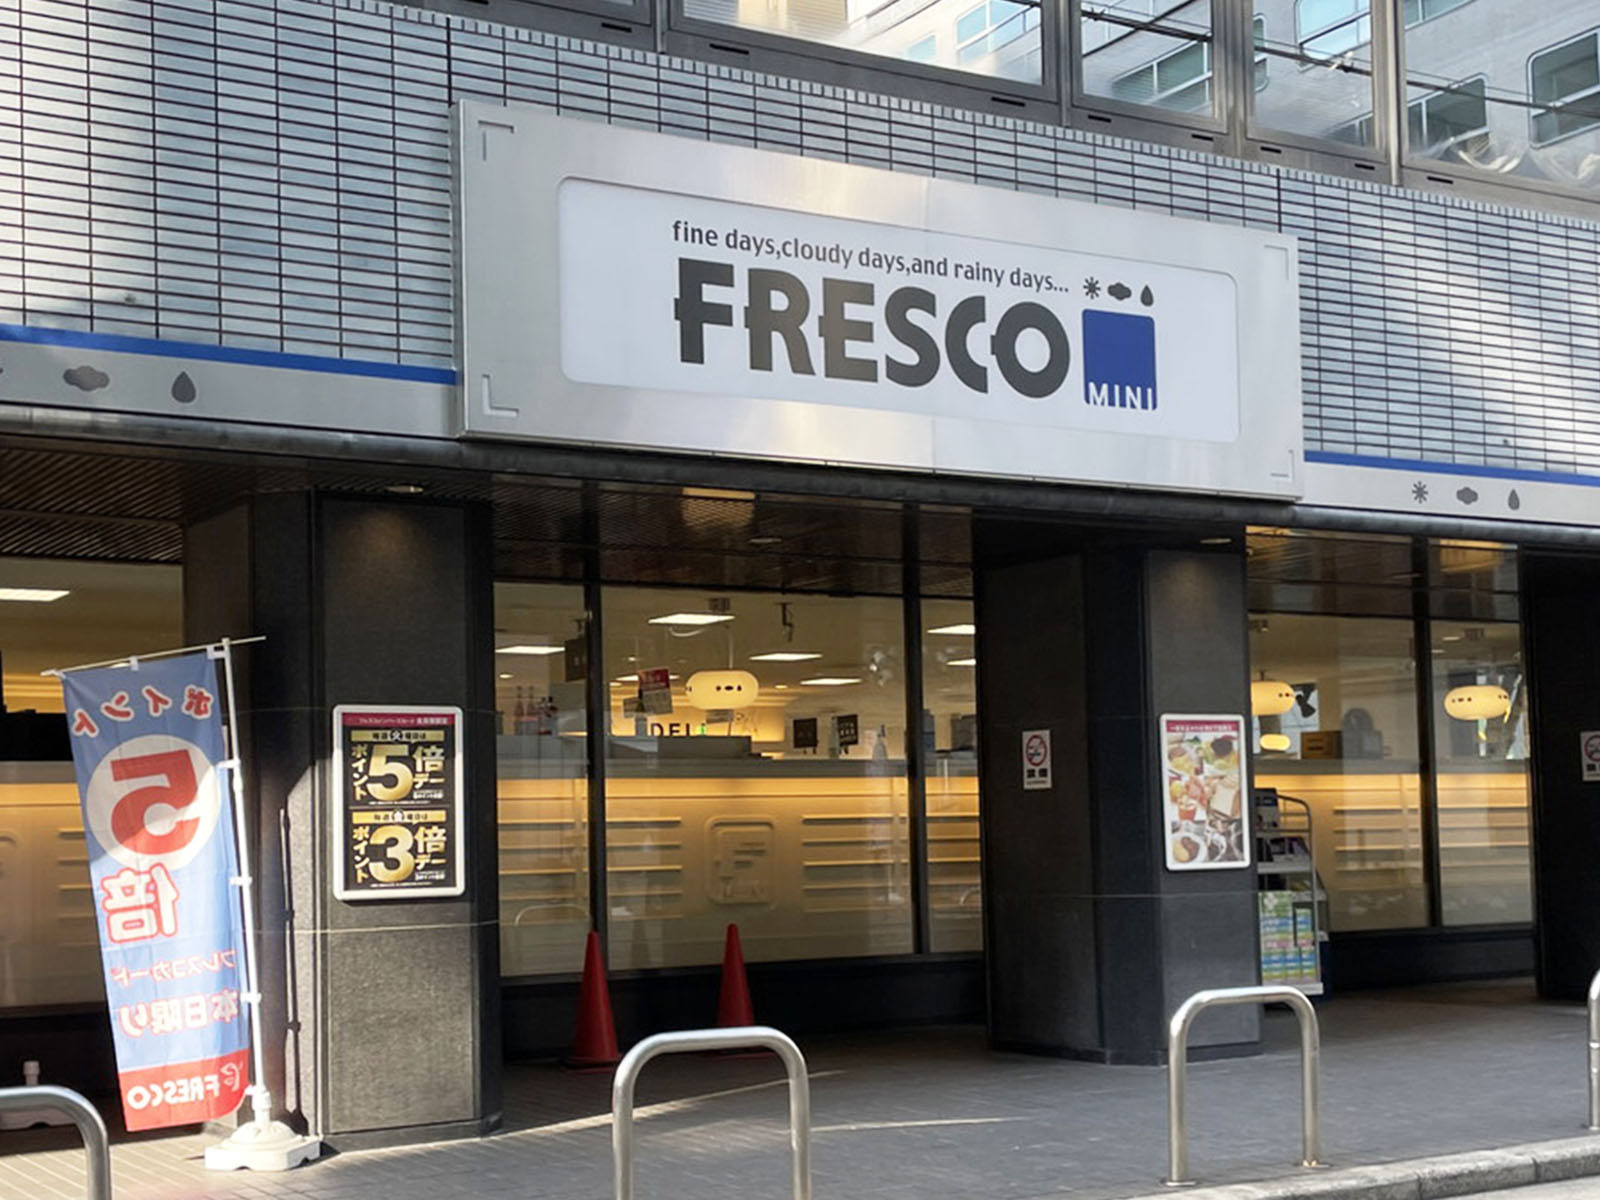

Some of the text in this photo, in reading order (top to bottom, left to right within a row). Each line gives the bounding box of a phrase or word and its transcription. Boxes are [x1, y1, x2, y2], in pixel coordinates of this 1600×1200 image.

[672, 220, 719, 247] fine
[725, 228, 854, 268] days,cloudy
[858, 247, 949, 275] days,and
[953, 260, 1005, 288] rainy
[673, 257, 1071, 399] FRESCO
[1086, 380, 1156, 411] MINI
[351, 745, 369, 801] ポイント
[352, 826, 370, 884] ポイント
